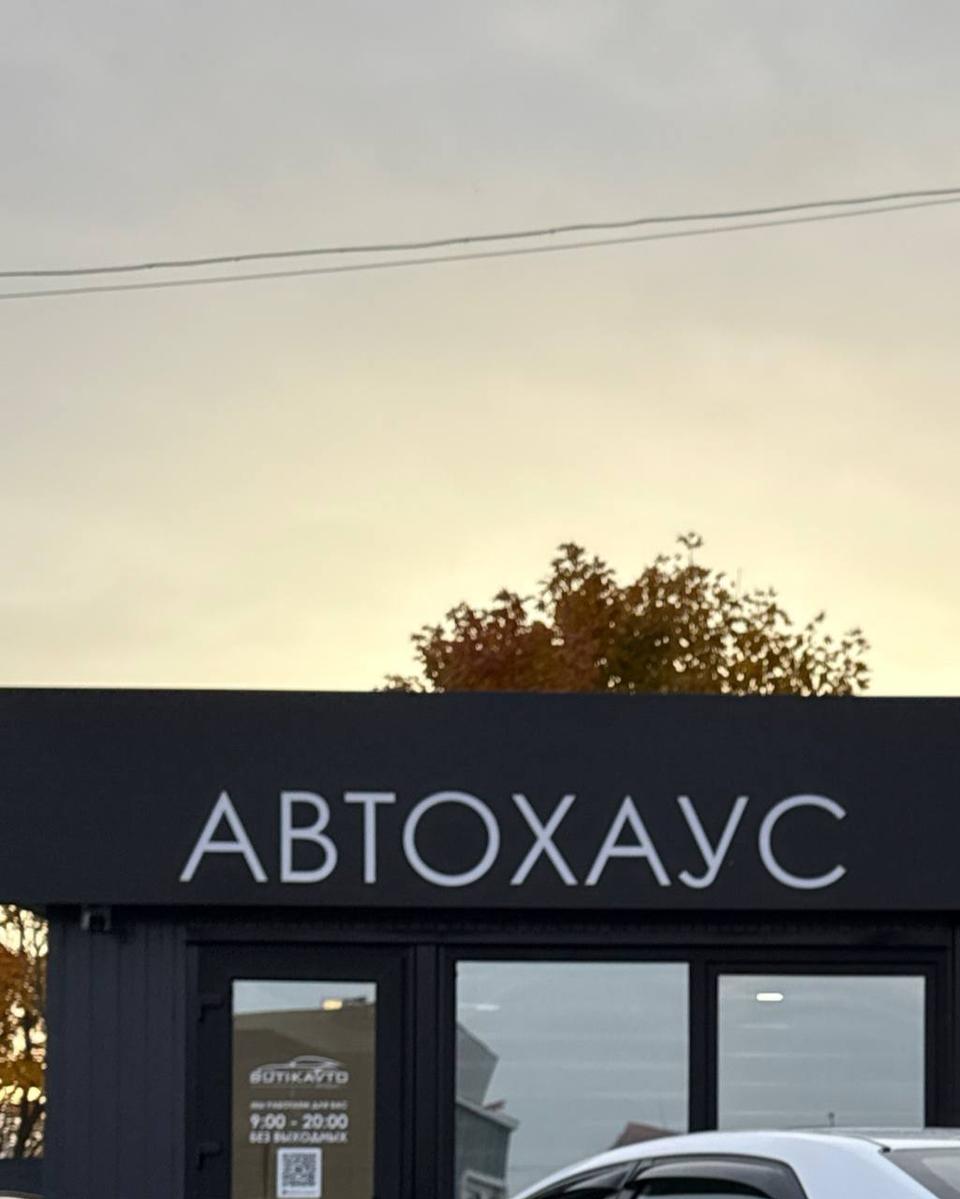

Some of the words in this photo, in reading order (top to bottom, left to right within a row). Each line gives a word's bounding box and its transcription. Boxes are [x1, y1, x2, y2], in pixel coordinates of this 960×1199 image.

[180, 791, 846, 889] АВТОХАУС
[249, 1070, 349, 1084] BUTIKAVTO
[250, 1113, 287, 1130] 9:00
[302, 1113, 349, 1130] 20:00
[249, 1131, 271, 1144] БЕЗ
[273, 1131, 348, 1144] ВЫХОДНЫХ
